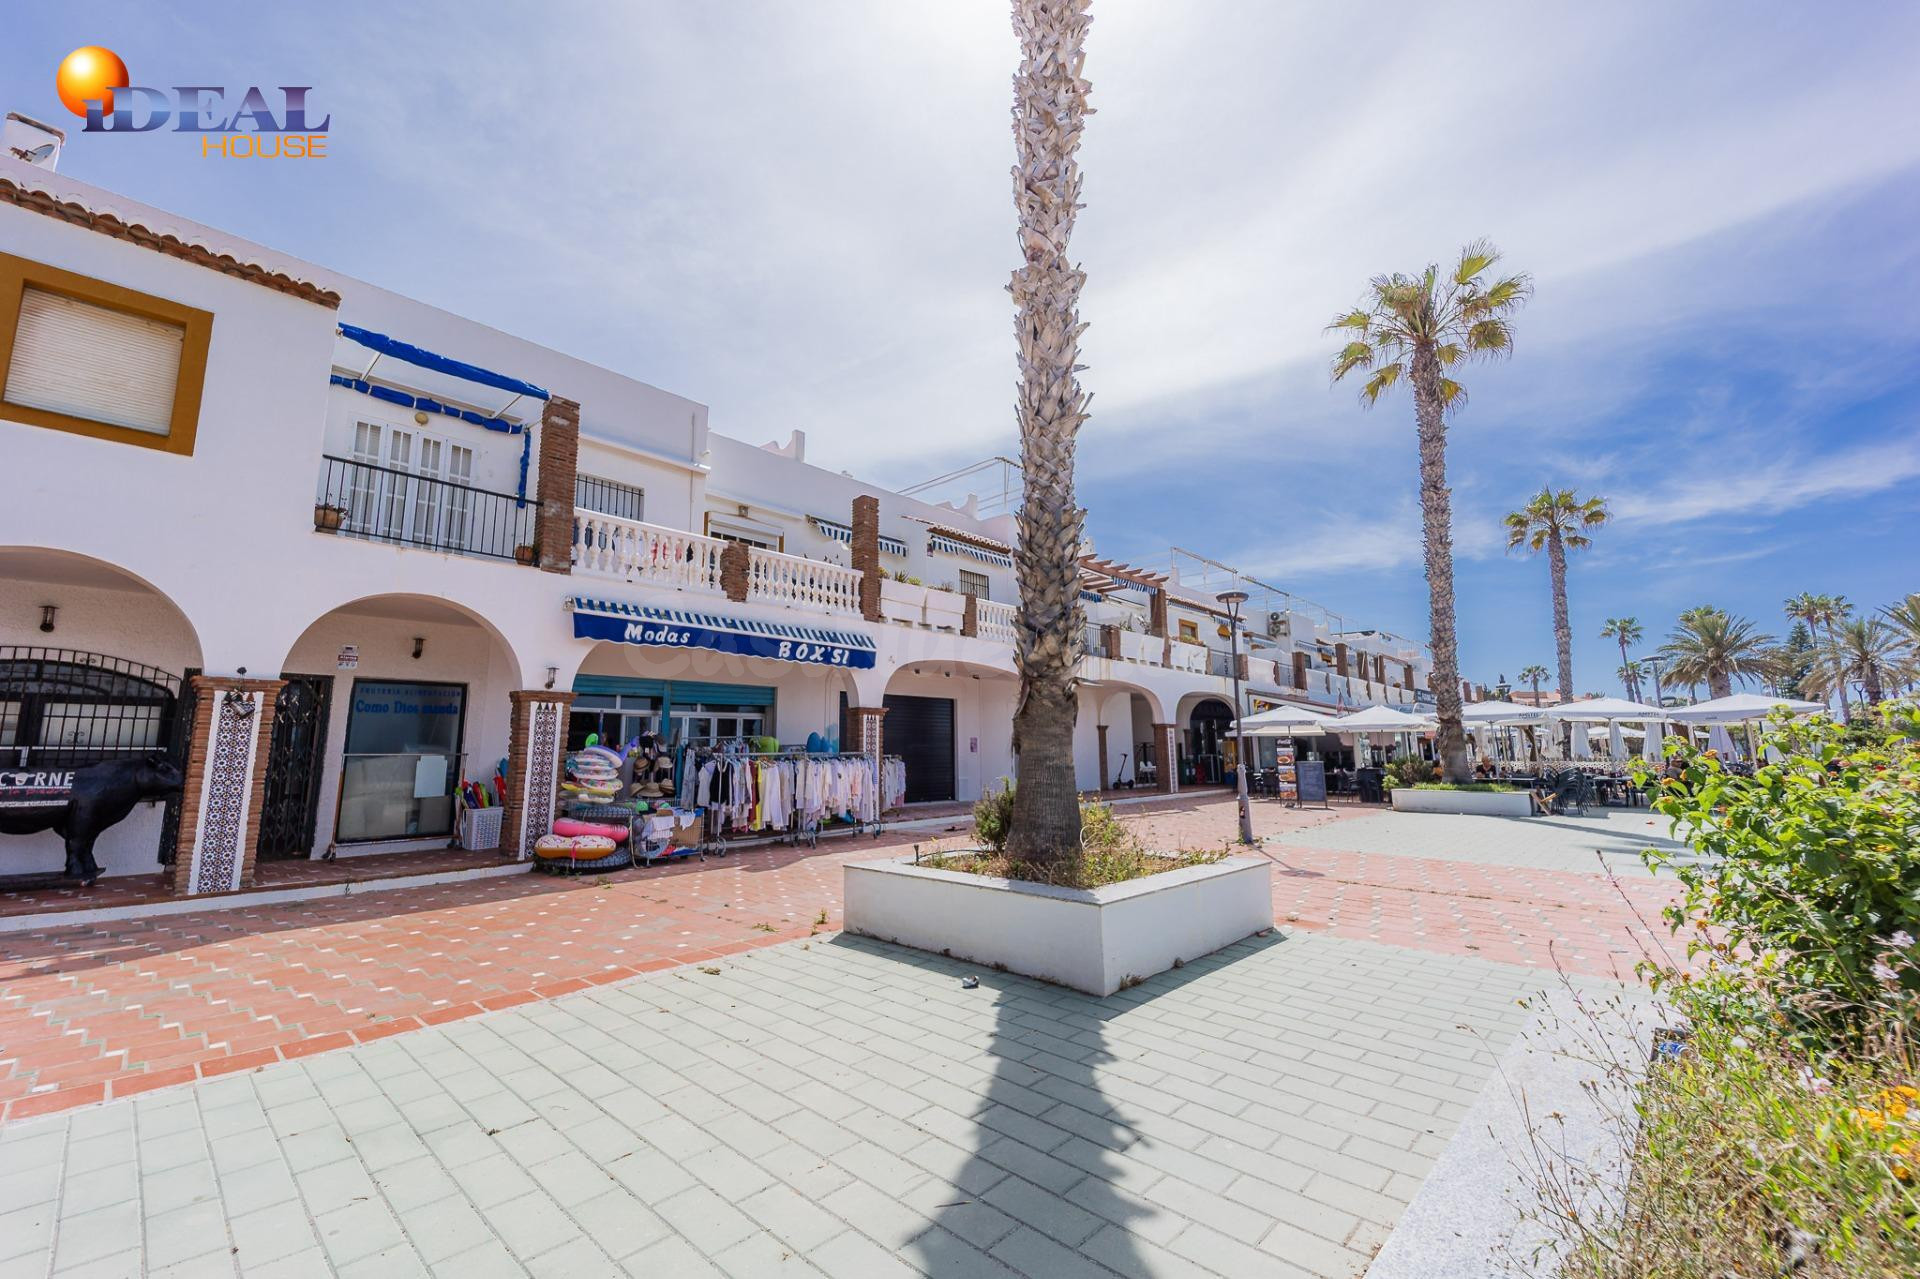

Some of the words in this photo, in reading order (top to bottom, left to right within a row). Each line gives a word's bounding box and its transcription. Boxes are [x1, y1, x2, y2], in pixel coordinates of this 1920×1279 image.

[624, 623, 691, 645] Modas
[355, 699, 390, 713] Como
[394, 700, 419, 714] Dios
